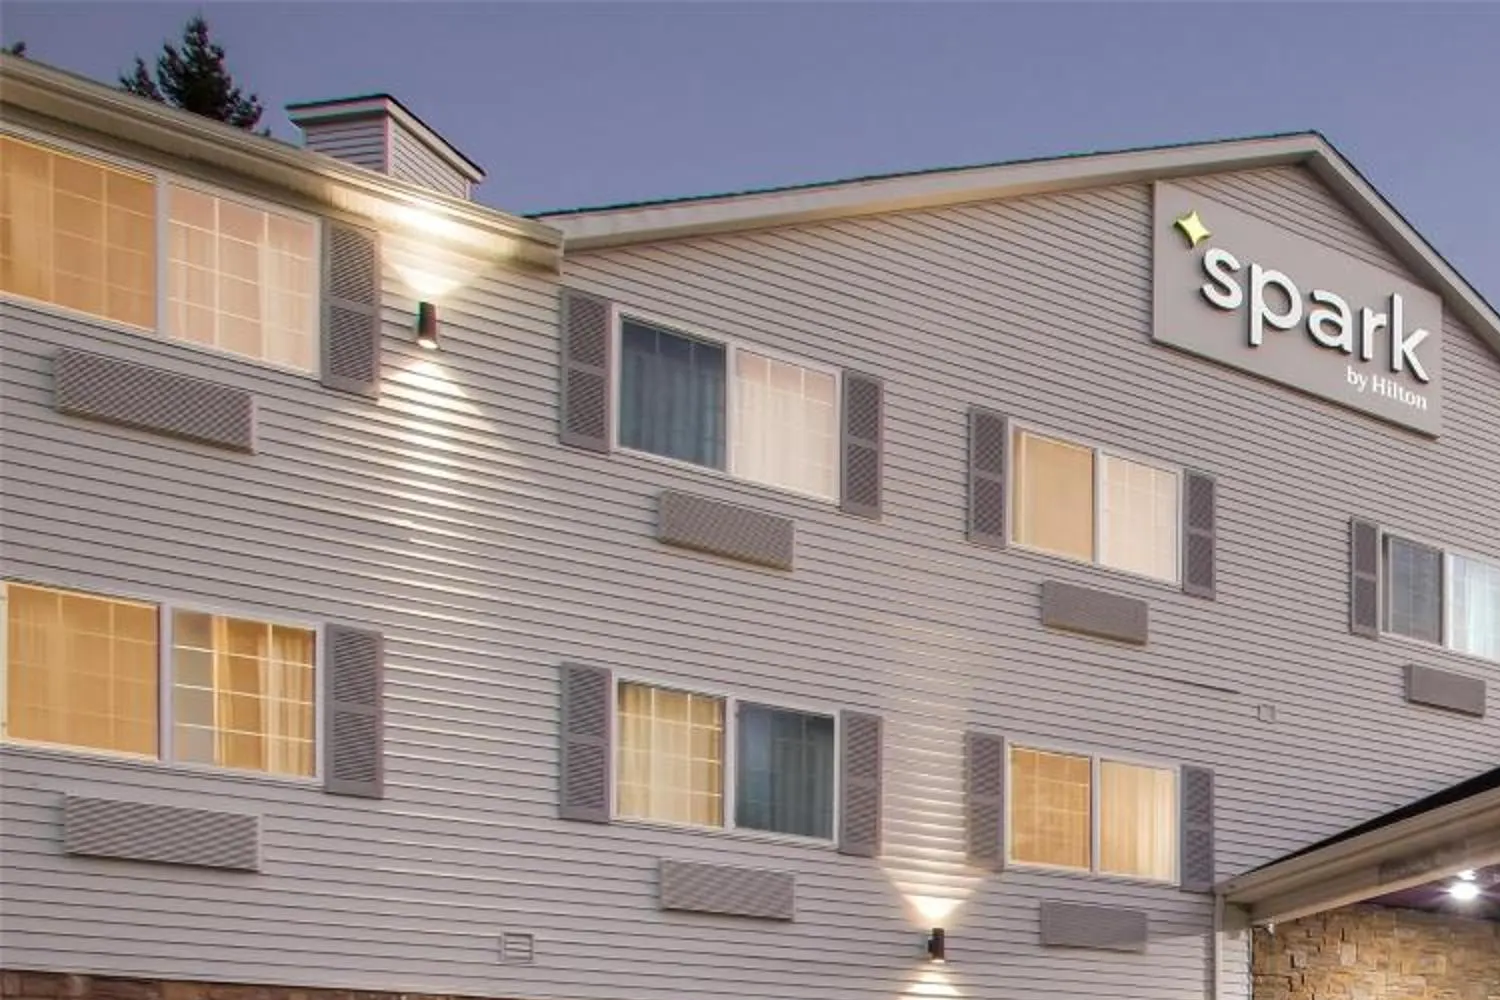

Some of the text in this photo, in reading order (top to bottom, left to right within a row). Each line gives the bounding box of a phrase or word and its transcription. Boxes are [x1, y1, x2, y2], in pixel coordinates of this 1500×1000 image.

[1200, 248, 1429, 383] spark
[1347, 365, 1427, 411] by Hilton
